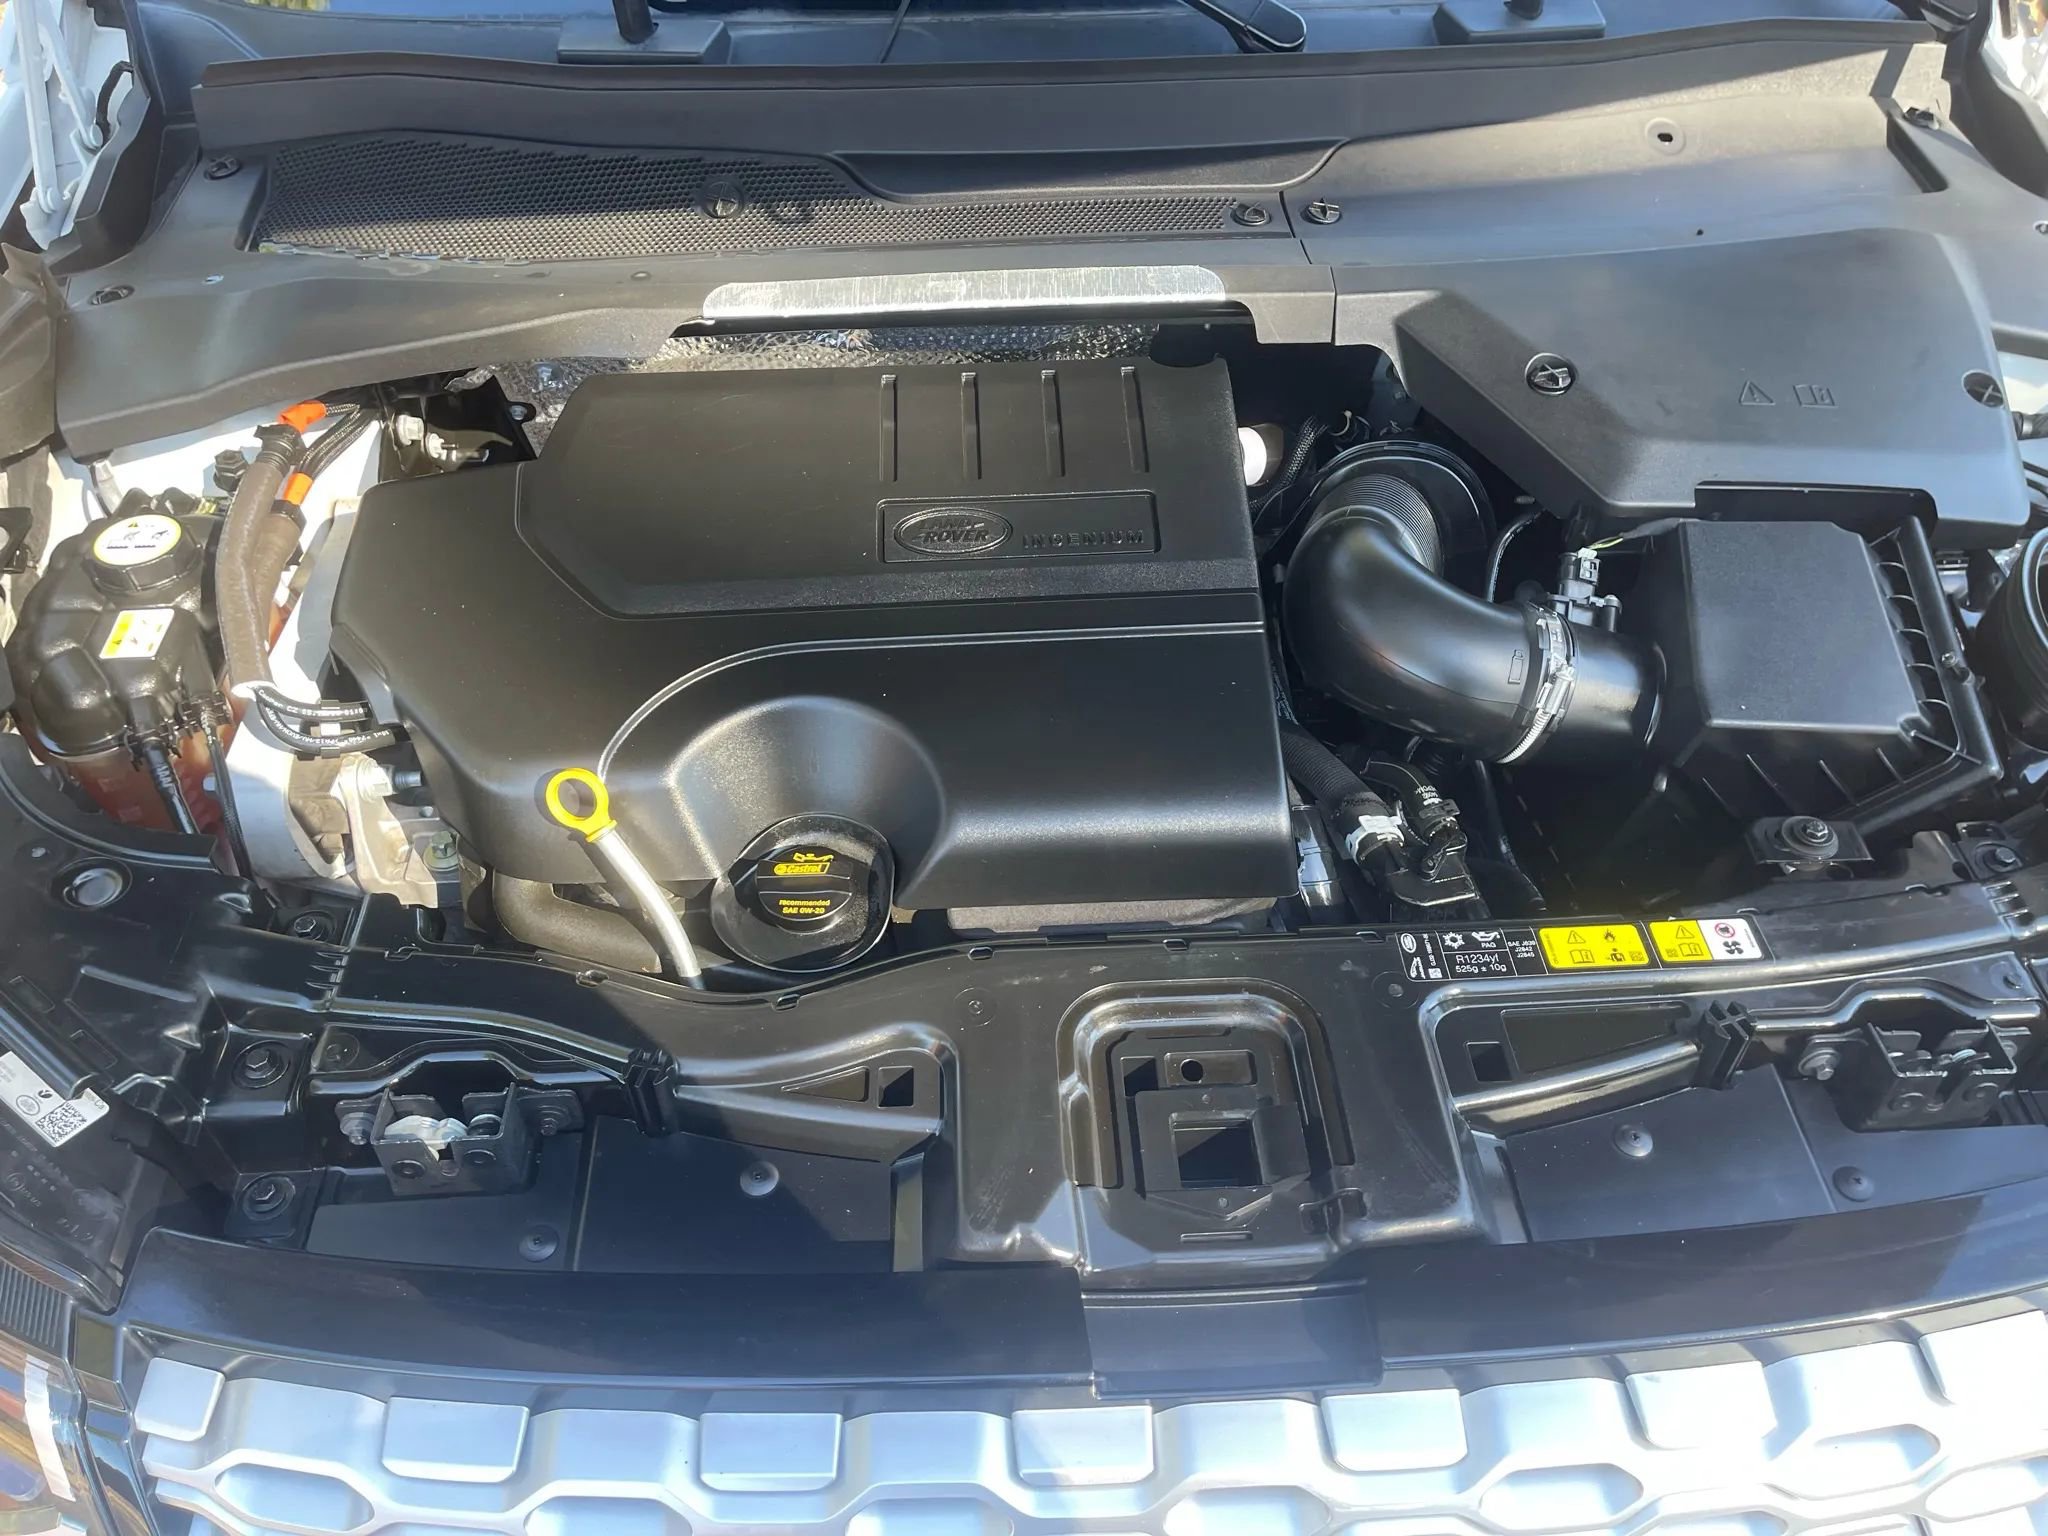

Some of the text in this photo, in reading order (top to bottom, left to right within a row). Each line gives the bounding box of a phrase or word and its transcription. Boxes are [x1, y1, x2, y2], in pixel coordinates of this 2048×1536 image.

[923, 529, 989, 544] ROVER
[1021, 529, 1145, 550] INGENIUM
[786, 864, 822, 873] Castrol
[782, 906, 825, 914] SAE 0W-20
[1455, 953, 1500, 965] R1234yf
[1455, 964, 1479, 974] 525g
[1489, 963, 1507, 973] 10g
